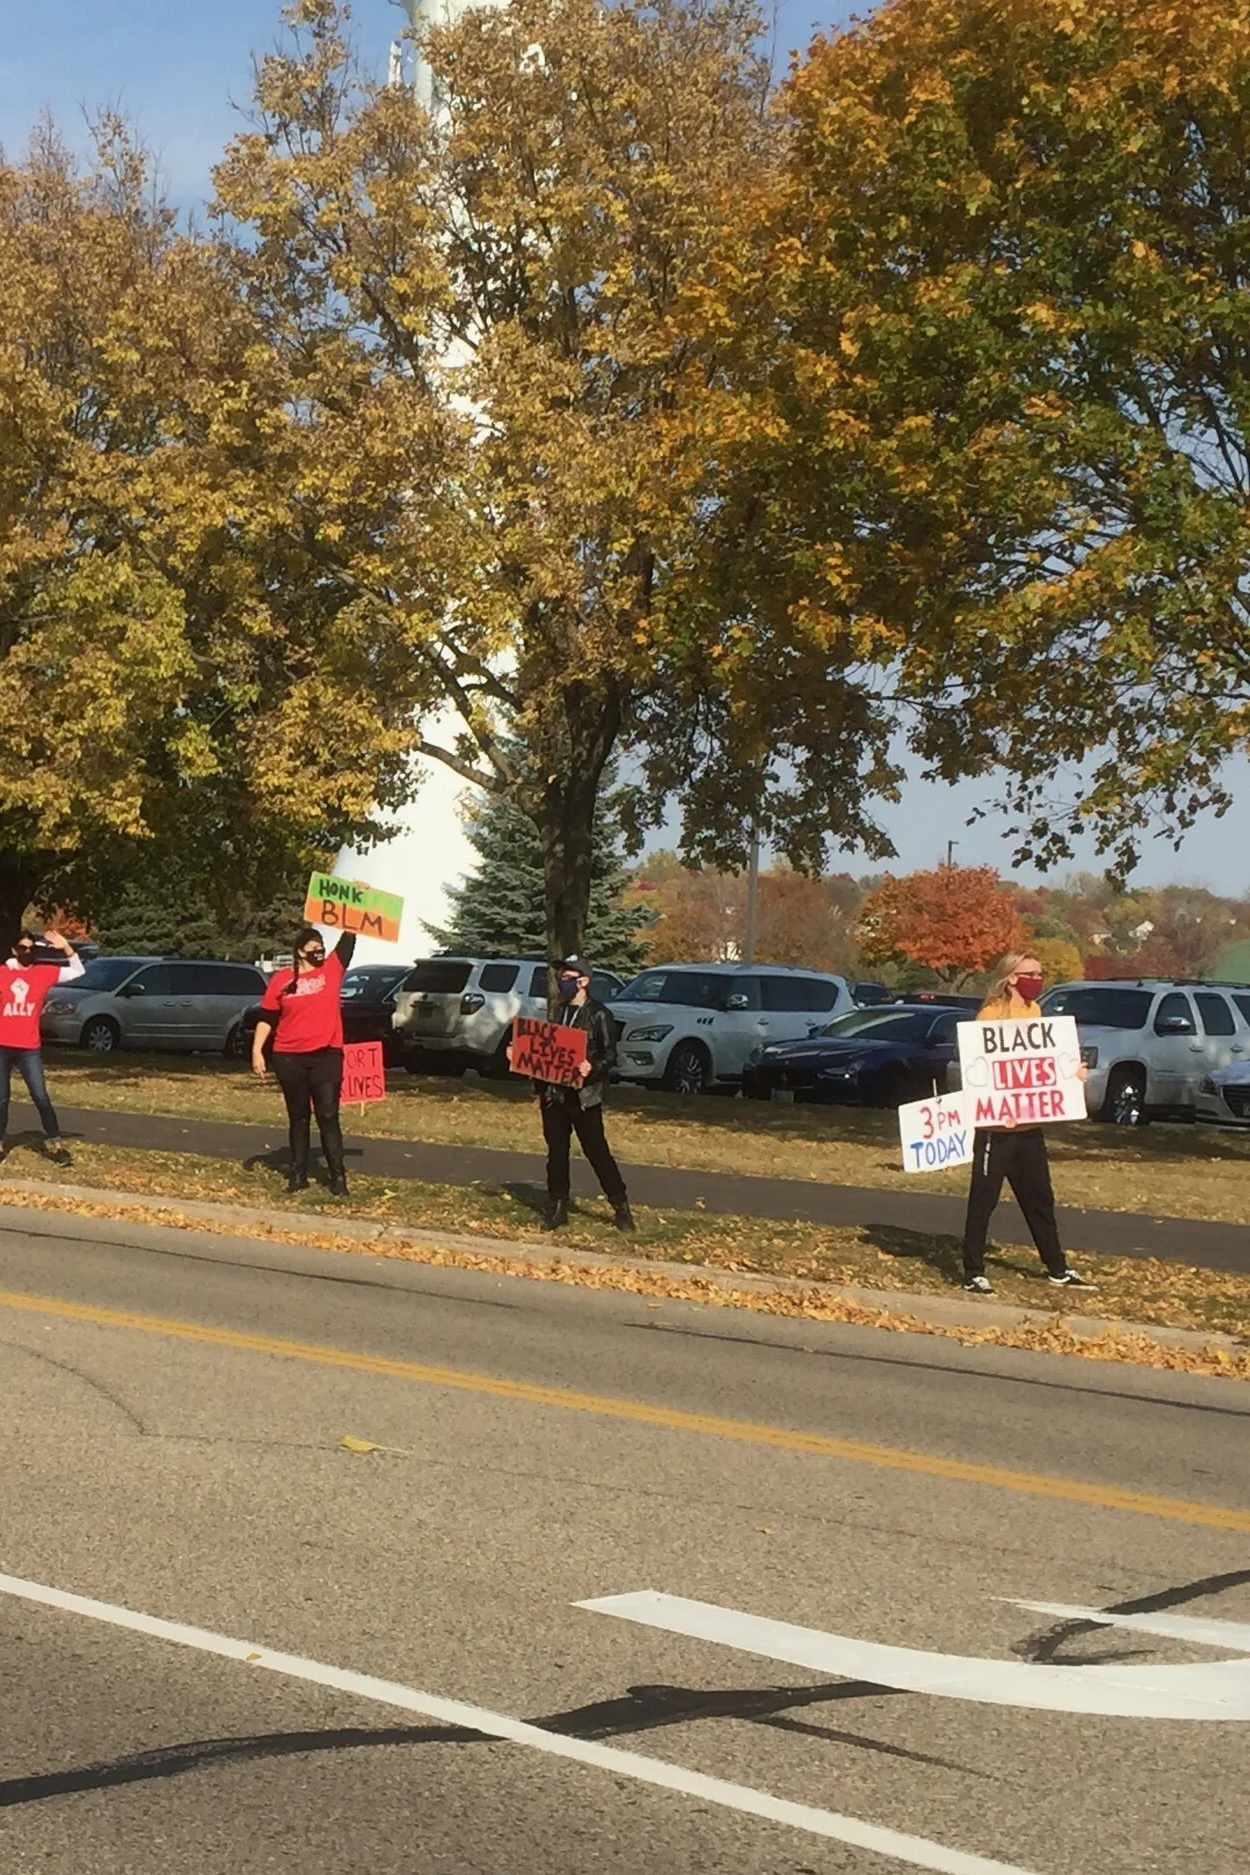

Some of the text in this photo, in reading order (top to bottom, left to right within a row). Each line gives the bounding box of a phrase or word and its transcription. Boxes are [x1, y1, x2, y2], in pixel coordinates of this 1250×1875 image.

[318, 879, 363, 903] HONK
[321, 899, 383, 936] BLM
[3, 1002, 36, 1017] ALLY
[517, 1018, 558, 1043] BLACK
[982, 1022, 1056, 1054] BLACK
[346, 1047, 379, 1069] ORT
[531, 1036, 577, 1067] LIVES
[516, 1051, 582, 1085] MATTER
[993, 1057, 1056, 1089] LIVES
[347, 1074, 384, 1098] LIVES
[975, 1090, 1066, 1122] MATTER
[920, 1106, 961, 1140] 3 PM
[910, 1130, 967, 1169] TODAY
